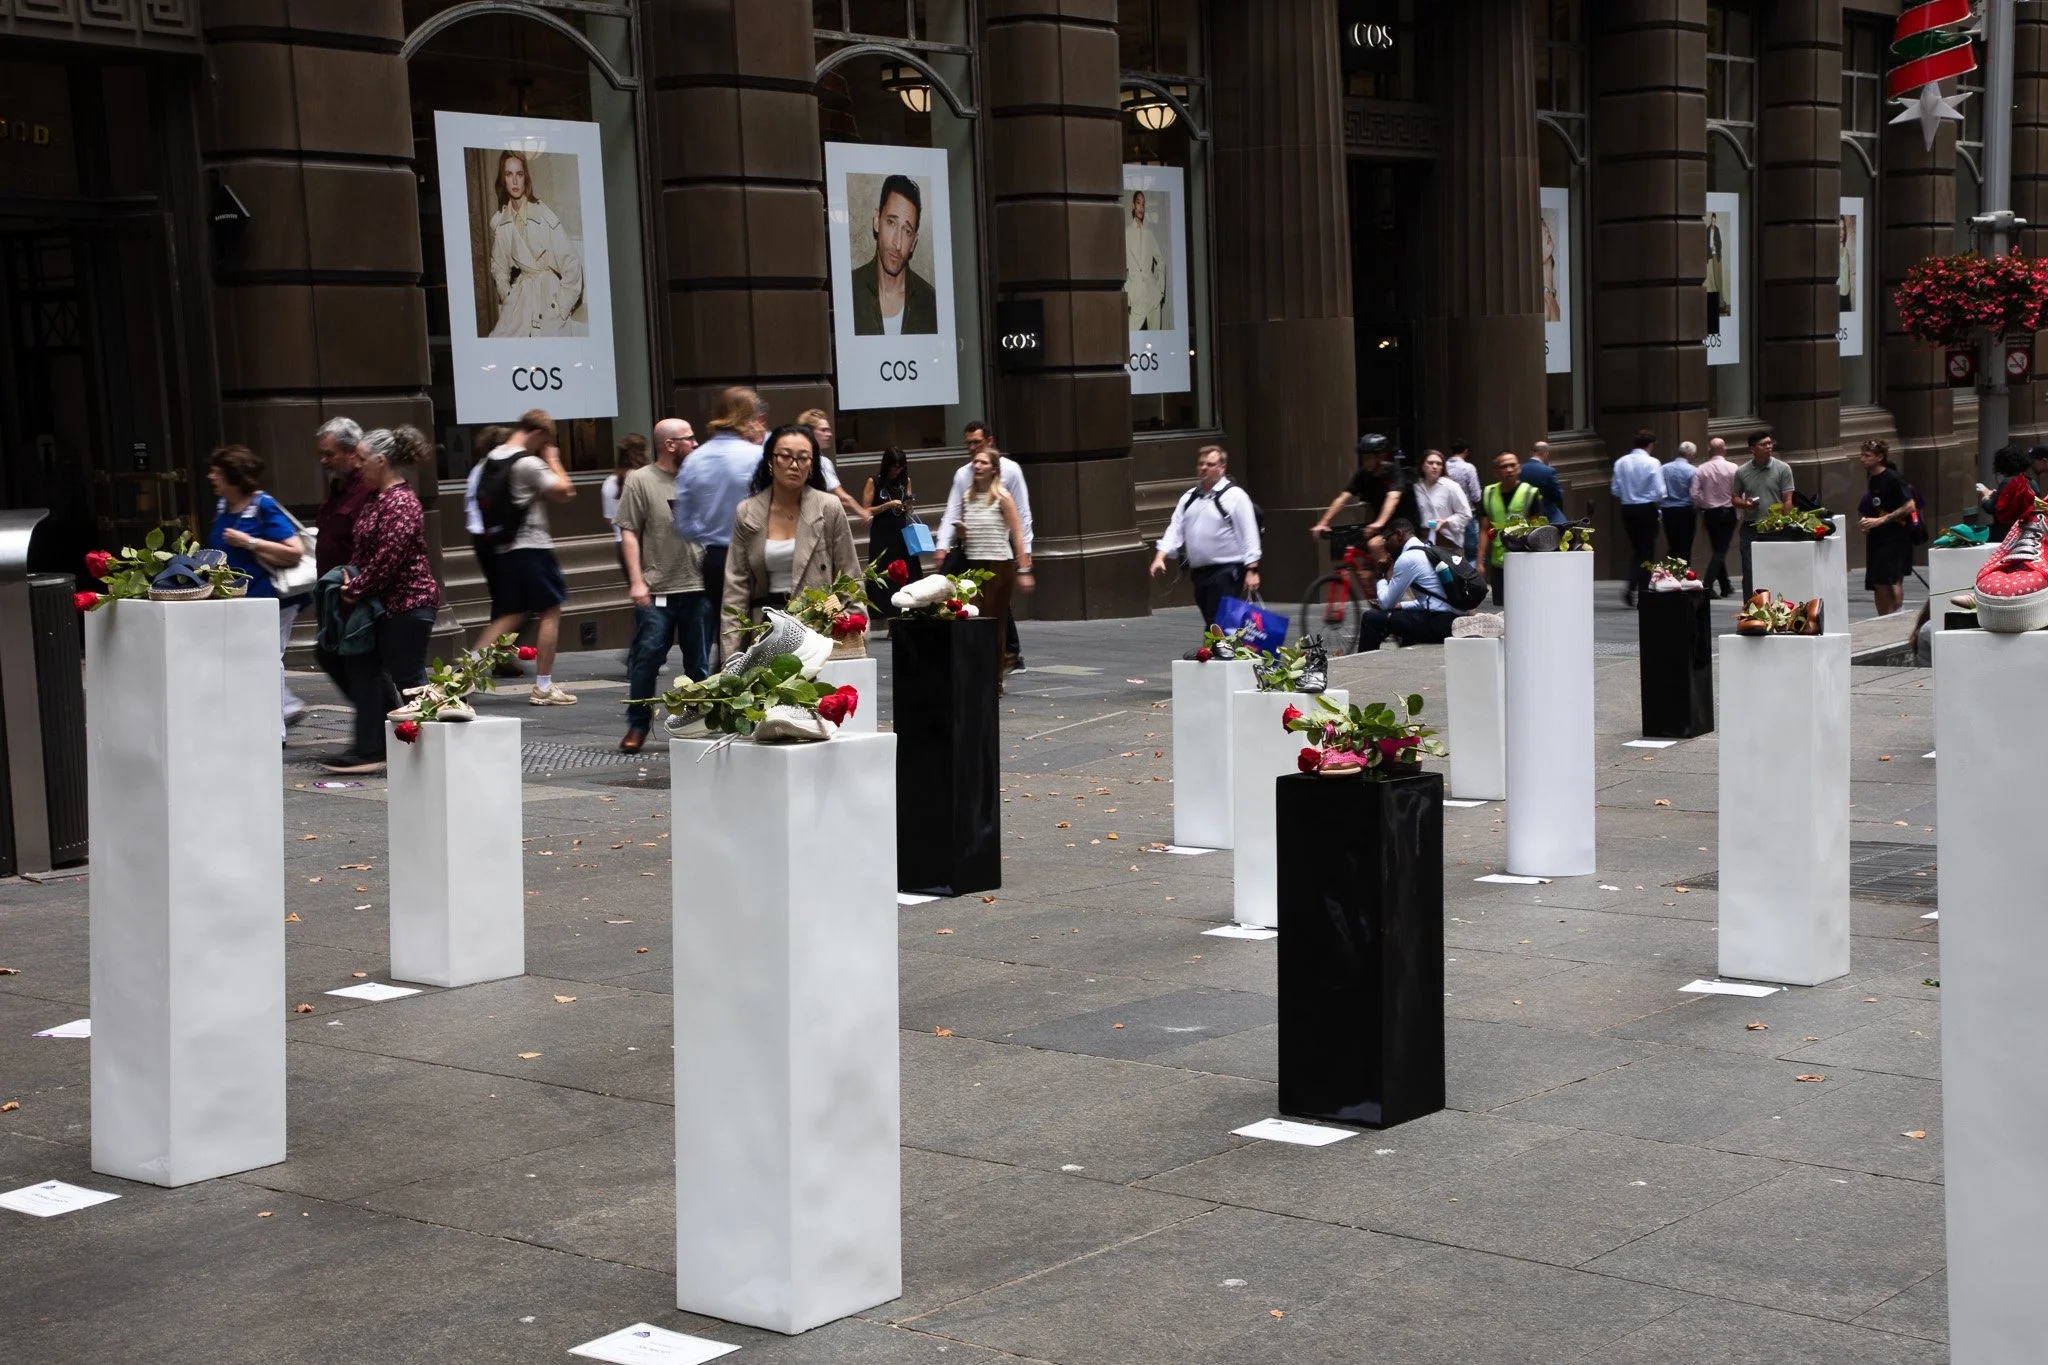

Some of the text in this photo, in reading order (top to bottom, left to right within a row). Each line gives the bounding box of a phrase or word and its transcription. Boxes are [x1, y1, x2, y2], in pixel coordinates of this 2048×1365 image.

[1354, 23, 1393, 48] COS
[1002, 333, 1035, 349] COS
[1705, 334, 1721, 347] COS
[880, 360, 918, 381] COS
[1129, 353, 1158, 371] COS
[512, 367, 563, 391] COS
